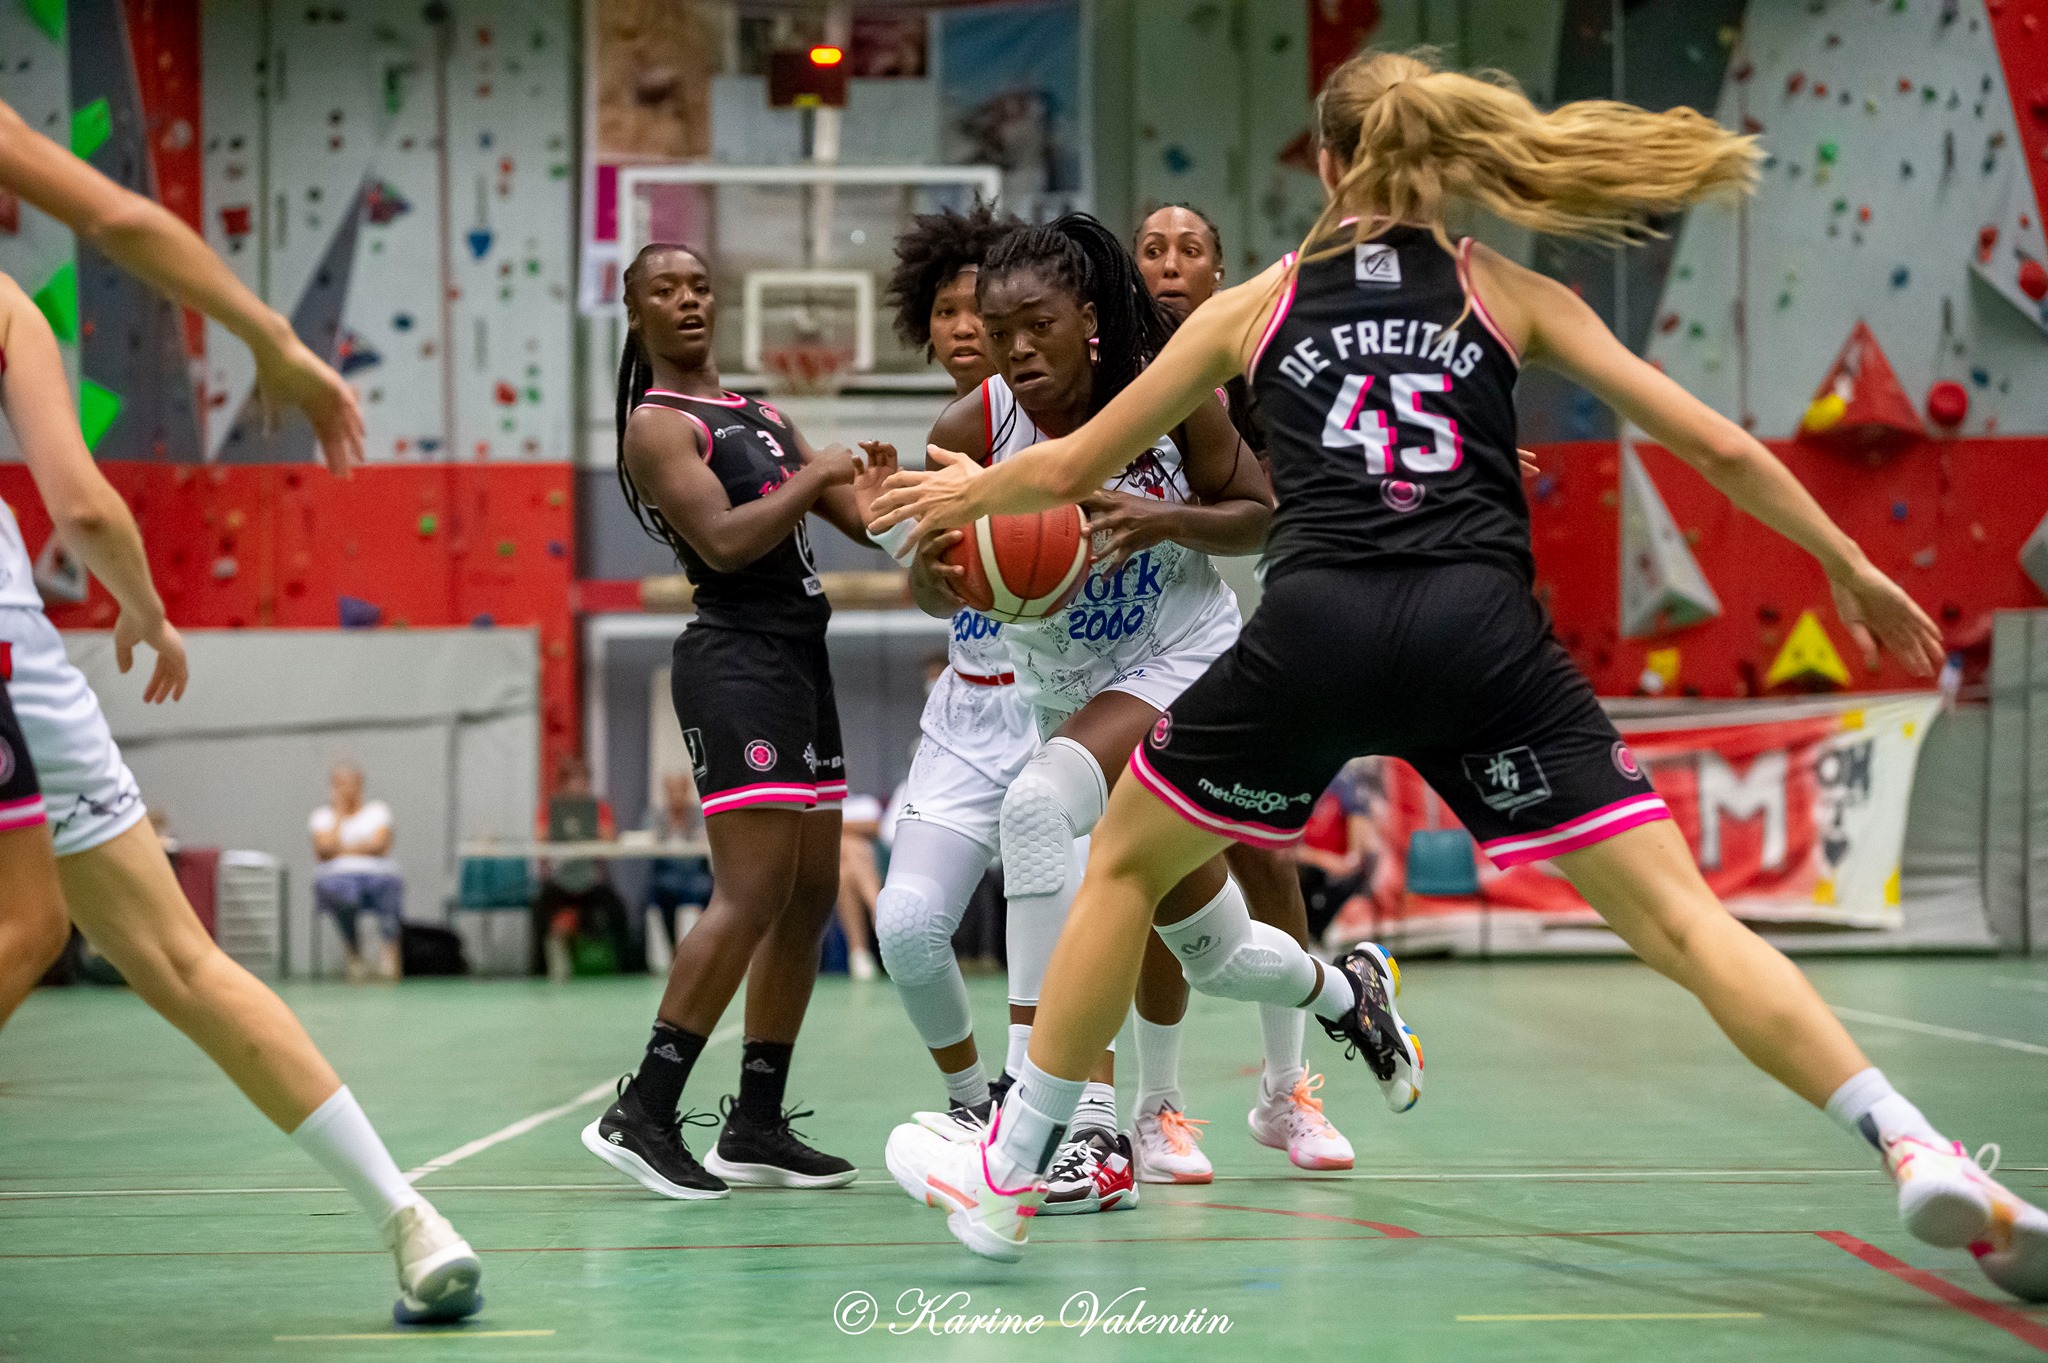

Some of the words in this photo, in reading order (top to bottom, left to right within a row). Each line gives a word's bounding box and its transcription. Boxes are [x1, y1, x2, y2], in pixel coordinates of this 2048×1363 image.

[1278, 336, 1331, 388] DE
[1331, 319, 1484, 378] FREITAS
[756, 430, 785, 457] 3
[1322, 373, 1464, 475] 45
[1082, 550, 1162, 602] ork
[1068, 604, 1145, 641] 2000
